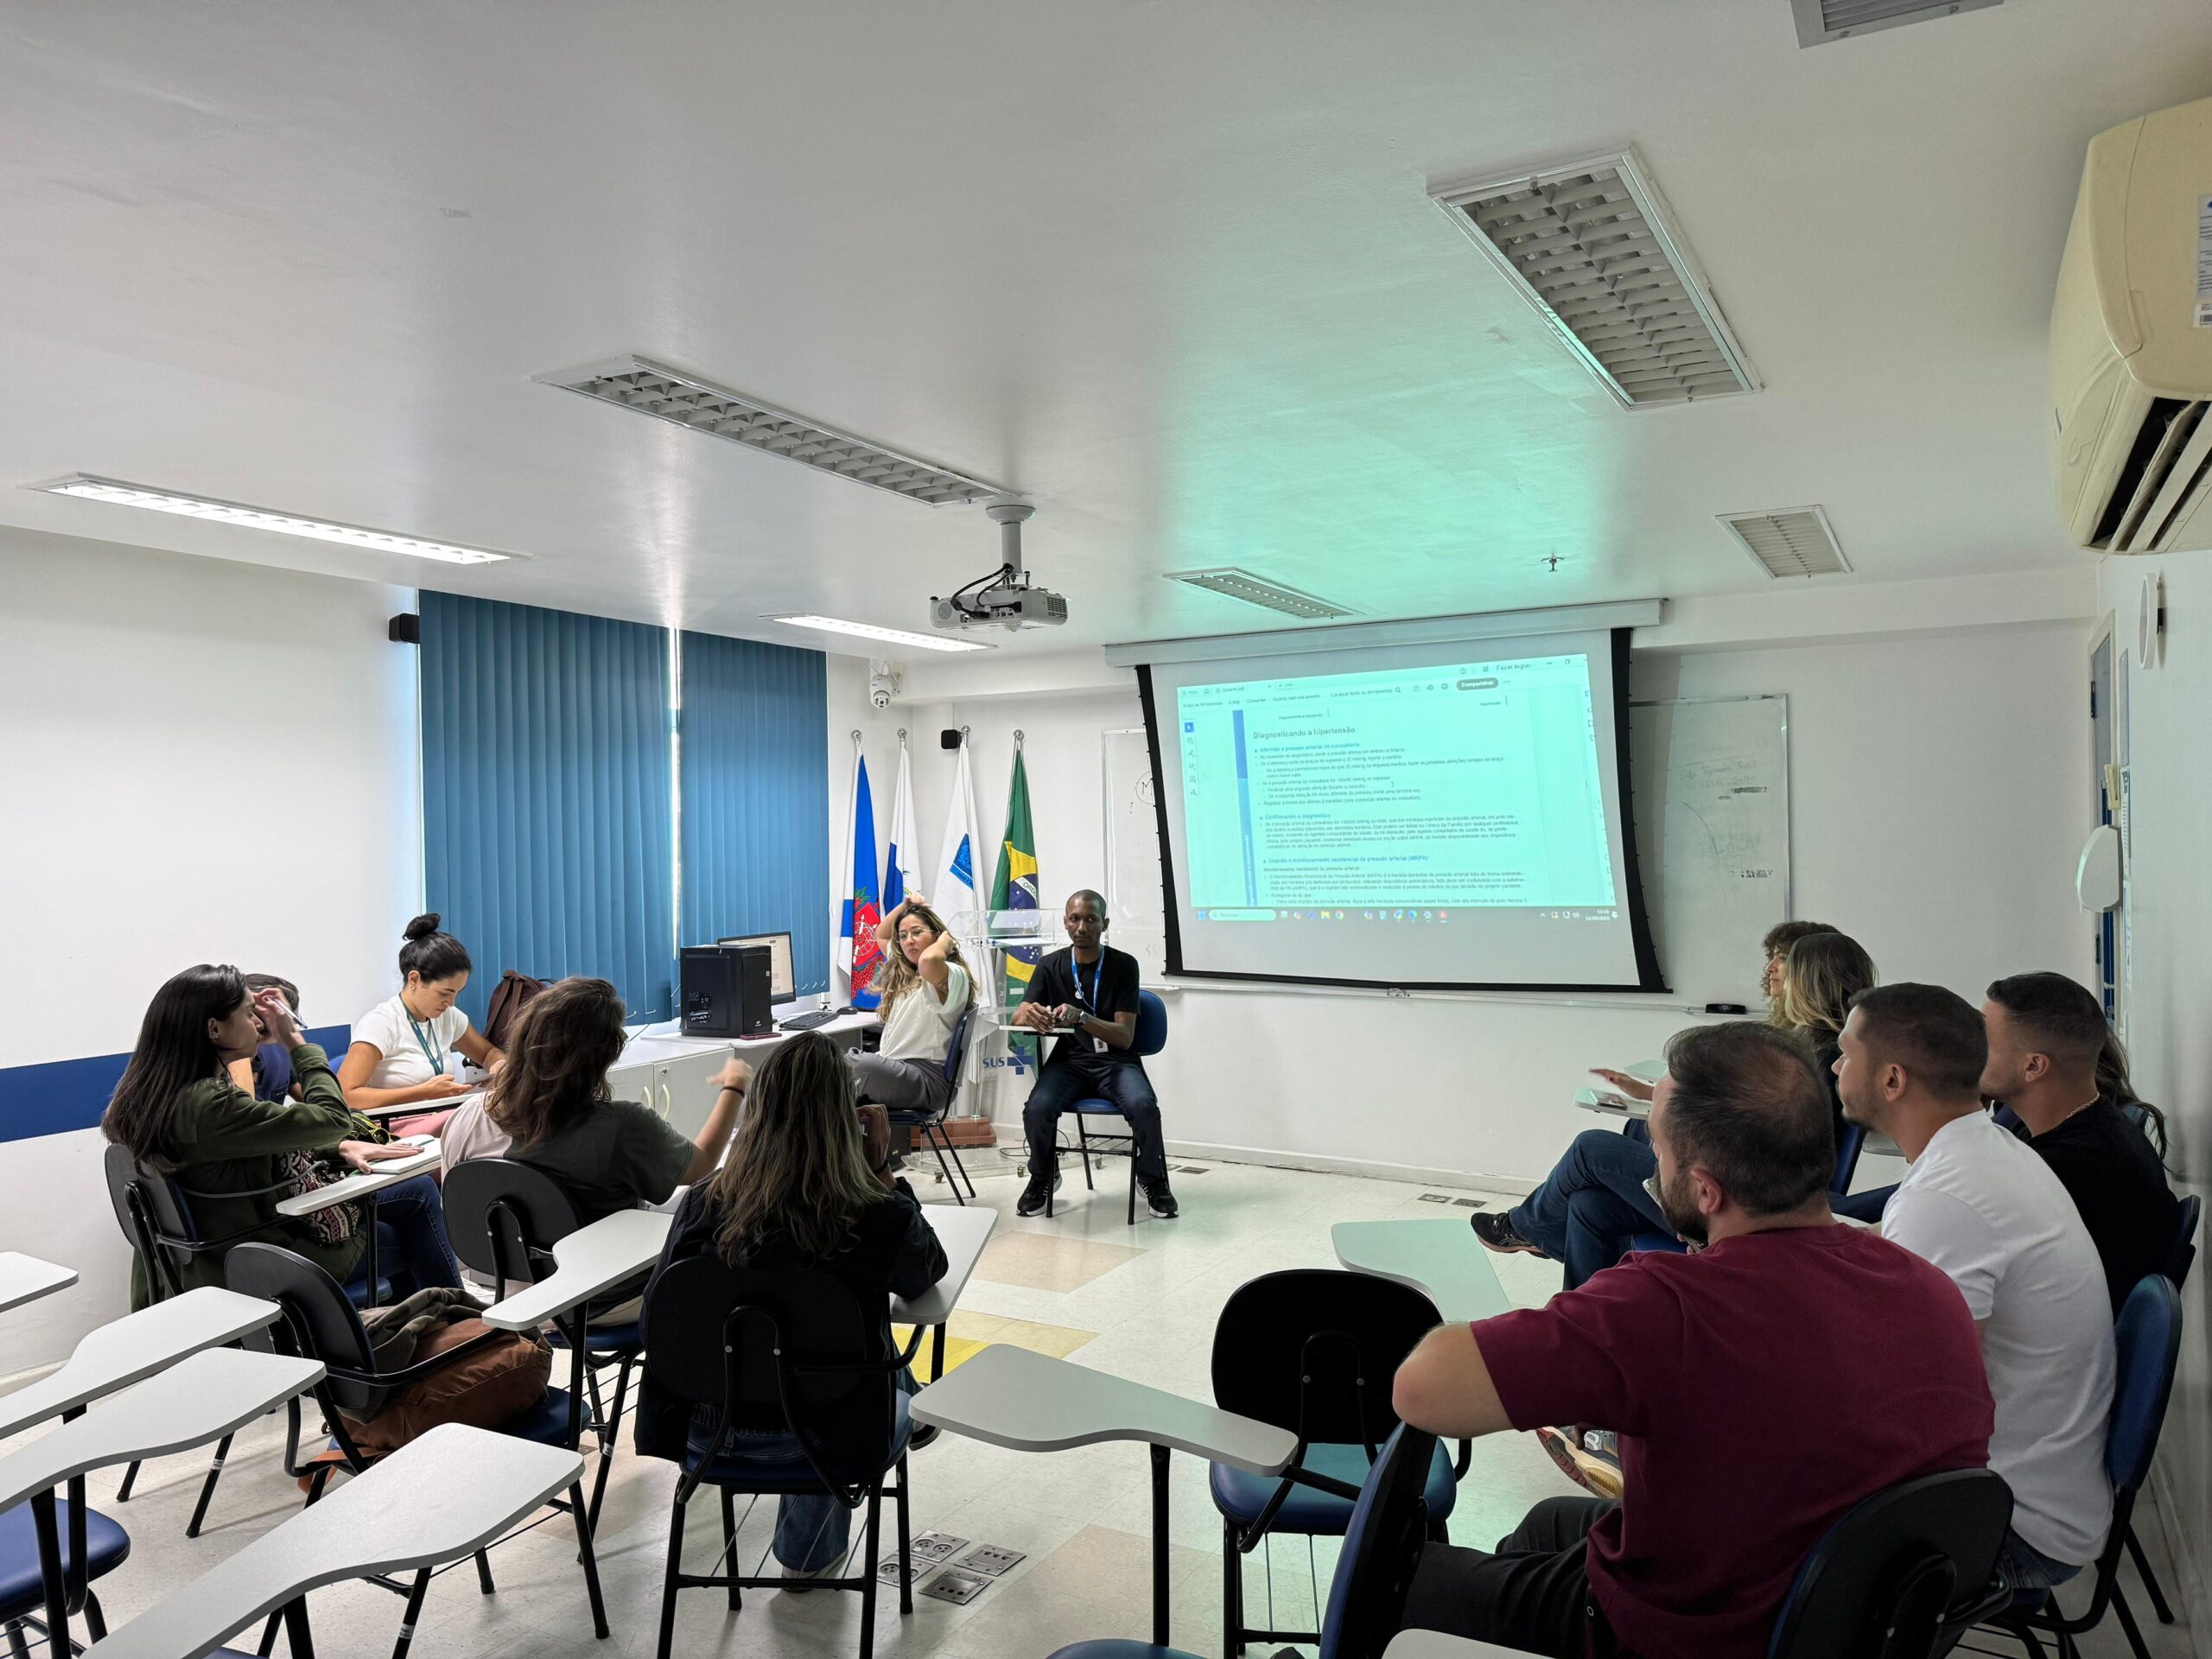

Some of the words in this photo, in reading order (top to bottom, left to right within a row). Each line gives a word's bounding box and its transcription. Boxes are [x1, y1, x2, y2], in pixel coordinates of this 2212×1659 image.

[1253, 728, 1306, 740] Diagnosticando
[1313, 725, 1355, 736] hipertensão
[982, 1057, 1005, 1068] SUS
